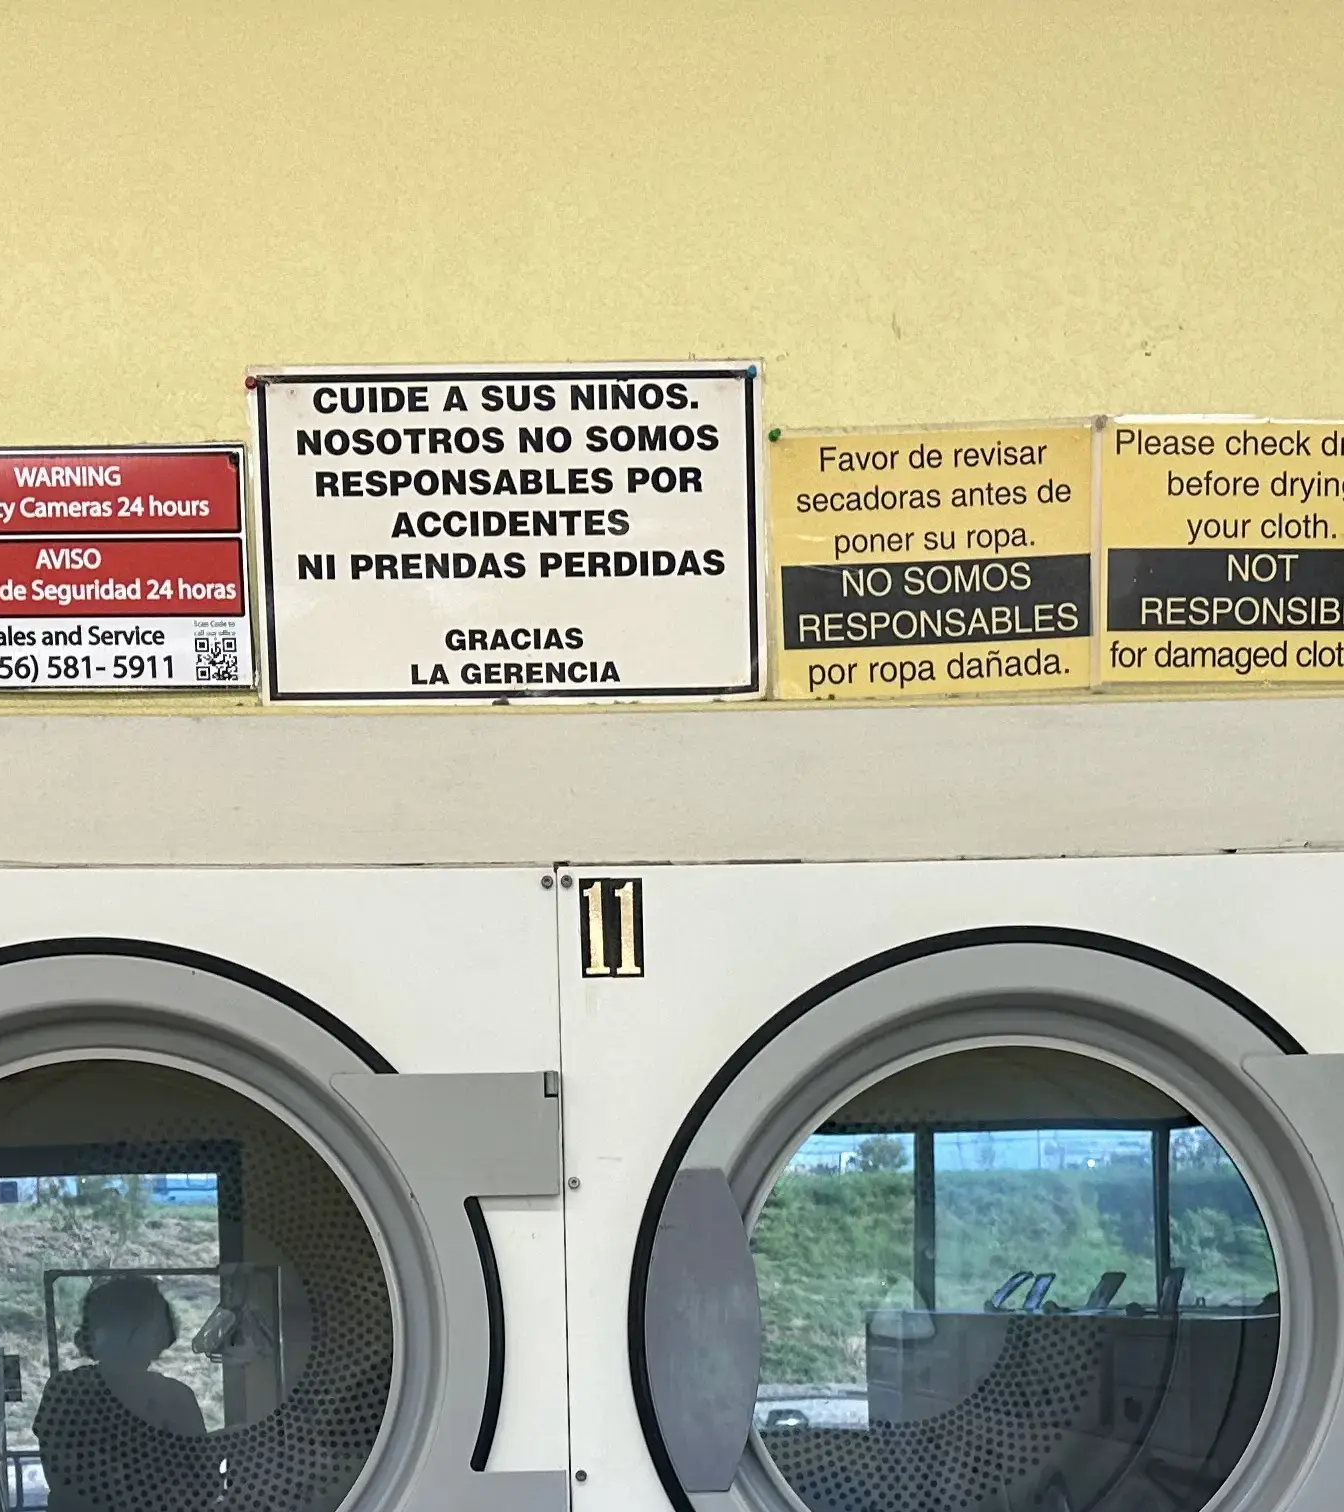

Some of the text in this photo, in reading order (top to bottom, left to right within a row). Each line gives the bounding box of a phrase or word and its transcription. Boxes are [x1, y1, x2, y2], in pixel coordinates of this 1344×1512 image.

[312, 387, 429, 413] CUIDE
[443, 386, 468, 412] A
[481, 385, 556, 412] SUS
[297, 424, 719, 455] NOSOTROS NO SOMOS
[1115, 428, 1215, 456] Please
[1225, 429, 1311, 456] check
[819, 440, 1048, 473] Favor de revisar
[14, 466, 121, 487] WARNING
[315, 467, 703, 497] RESPONSABLES POR
[1167, 470, 1260, 497] before
[19, 497, 113, 518] Cameras
[116, 497, 144, 517] 24
[149, 495, 210, 517] hours
[796, 479, 1072, 513] secadoras antes de
[391, 509, 630, 538] ACCIDENTES
[1186, 512, 1337, 545] your cloth.
[834, 526, 1036, 561] poner su ropa.
[35, 548, 101, 570] AVISO
[297, 549, 726, 580] NI PRENDAS PERDIDAS
[1227, 553, 1299, 583] NOT
[31, 578, 141, 606] Seguridad
[146, 580, 174, 600] 24
[178, 579, 237, 599] horas
[841, 561, 1032, 598] NO SOMOS
[41, 626, 82, 646] and
[88, 626, 166, 646] Service
[798, 602, 1079, 643] RESPONSABLES
[445, 628, 584, 651] GRACIAS
[113, 655, 175, 679] 5911
[808, 647, 1070, 693] por ropa dañada.
[1110, 640, 1147, 669] for
[1153, 640, 1288, 675] damaged
[410, 661, 621, 685] LA GERENCIA
[583, 881, 641, 975] 11
